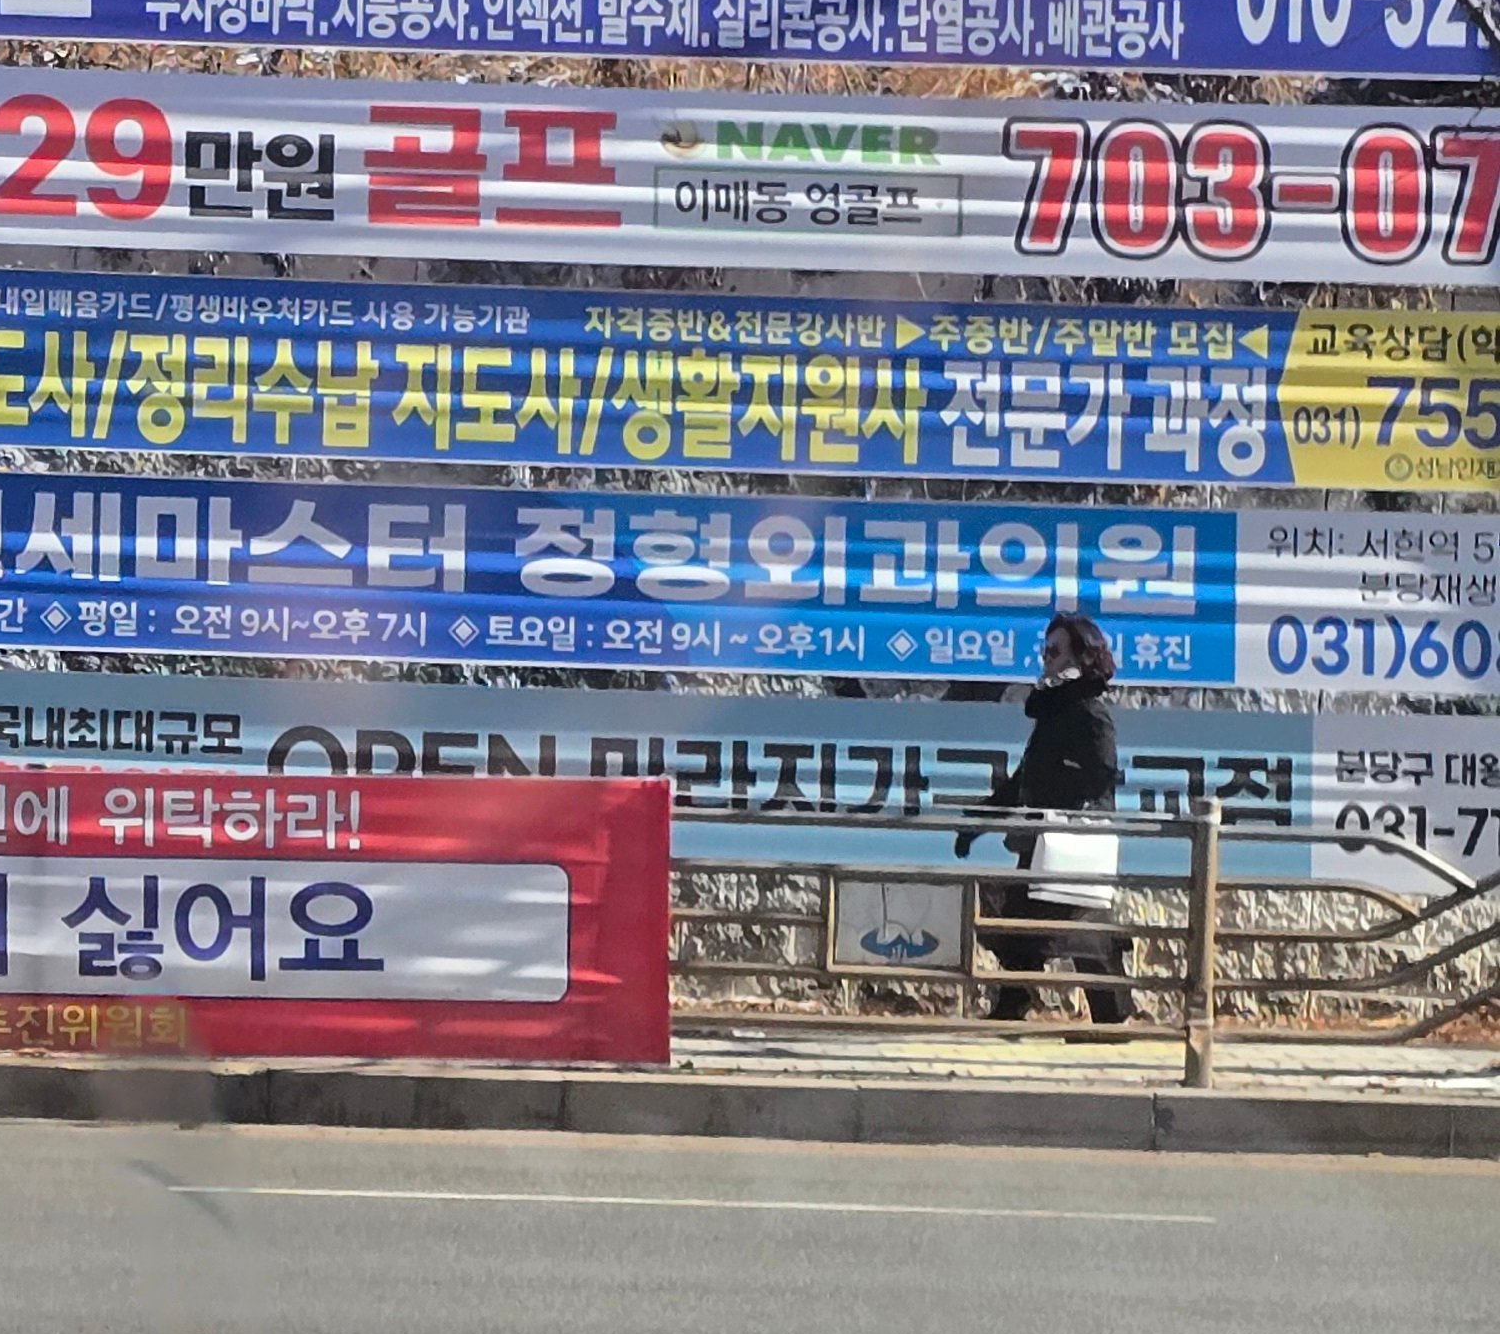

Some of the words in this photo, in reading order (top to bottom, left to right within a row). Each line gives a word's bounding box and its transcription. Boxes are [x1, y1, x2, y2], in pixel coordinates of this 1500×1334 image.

[716, 120, 941, 165] NAVER
[363, 105, 622, 227] 골프
[675, 179, 790, 224] 이매동
[1003, 116, 1500, 265] 703-07
[361, 301, 415, 331] 사용
[423, 303, 530, 334] 가능기관
[1168, 322, 1234, 360] 모집
[940, 361, 1124, 470] 전문가
[1143, 367, 1267, 477] 과정
[514, 507, 1197, 616] 정형외과의원
[171, 605, 230, 639] 오전
[603, 620, 662, 654] 오전
[925, 628, 1015, 666] 일요일
[1132, 633, 1192, 670] 휴진
[1268, 615, 1500, 679] 031)60
[1336, 751, 1433, 786] 분당구
[99, 785, 363, 851] 위탁하라!
[61, 874, 385, 982] 싫어요
